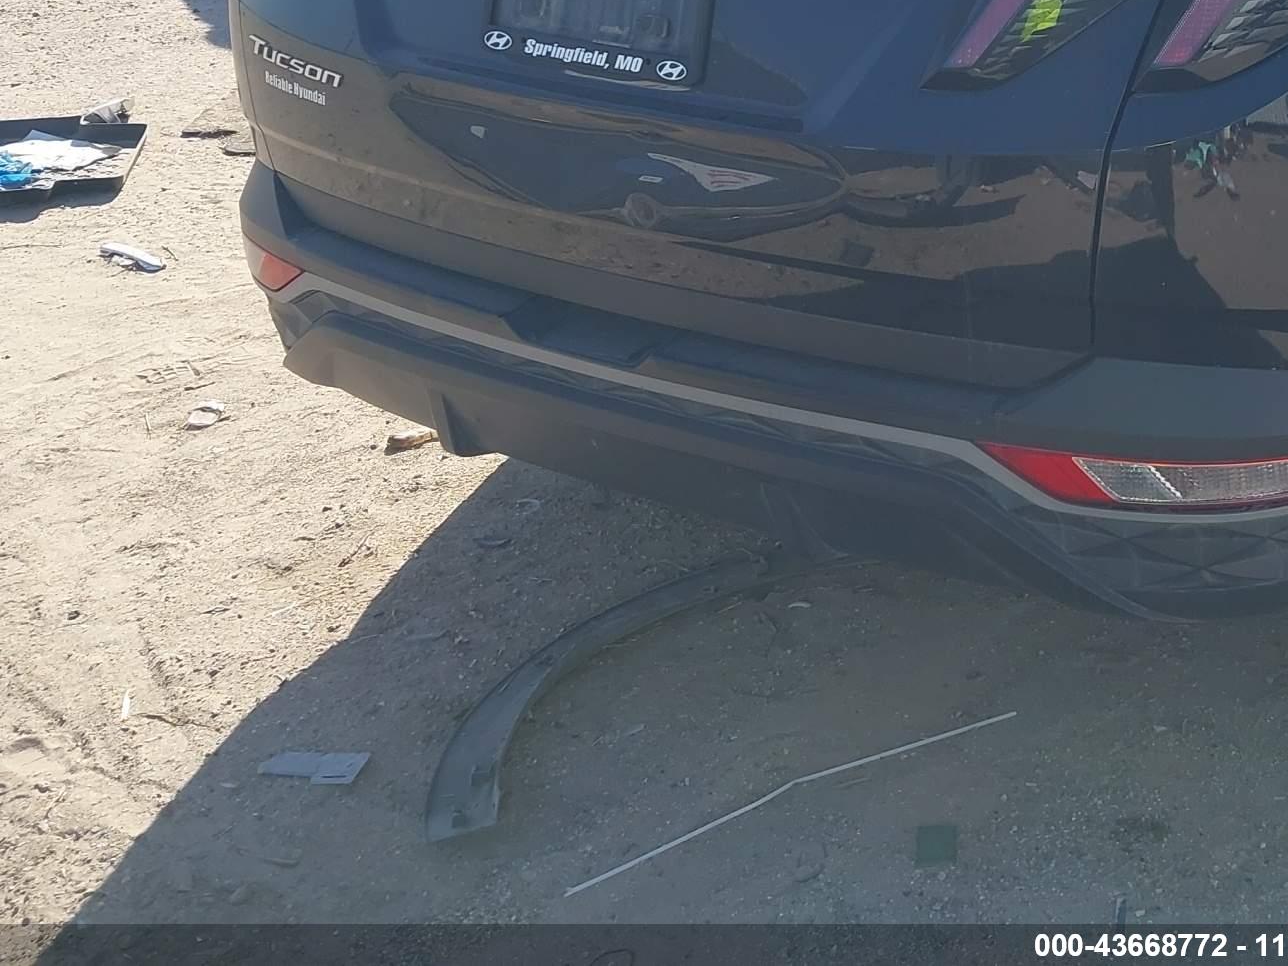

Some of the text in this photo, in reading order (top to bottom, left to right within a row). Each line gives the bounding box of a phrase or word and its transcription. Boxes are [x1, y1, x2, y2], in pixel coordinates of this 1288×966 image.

[524, 38, 644, 73] Springfield, MO
[265, 70, 326, 106] Reliable Hyundai
